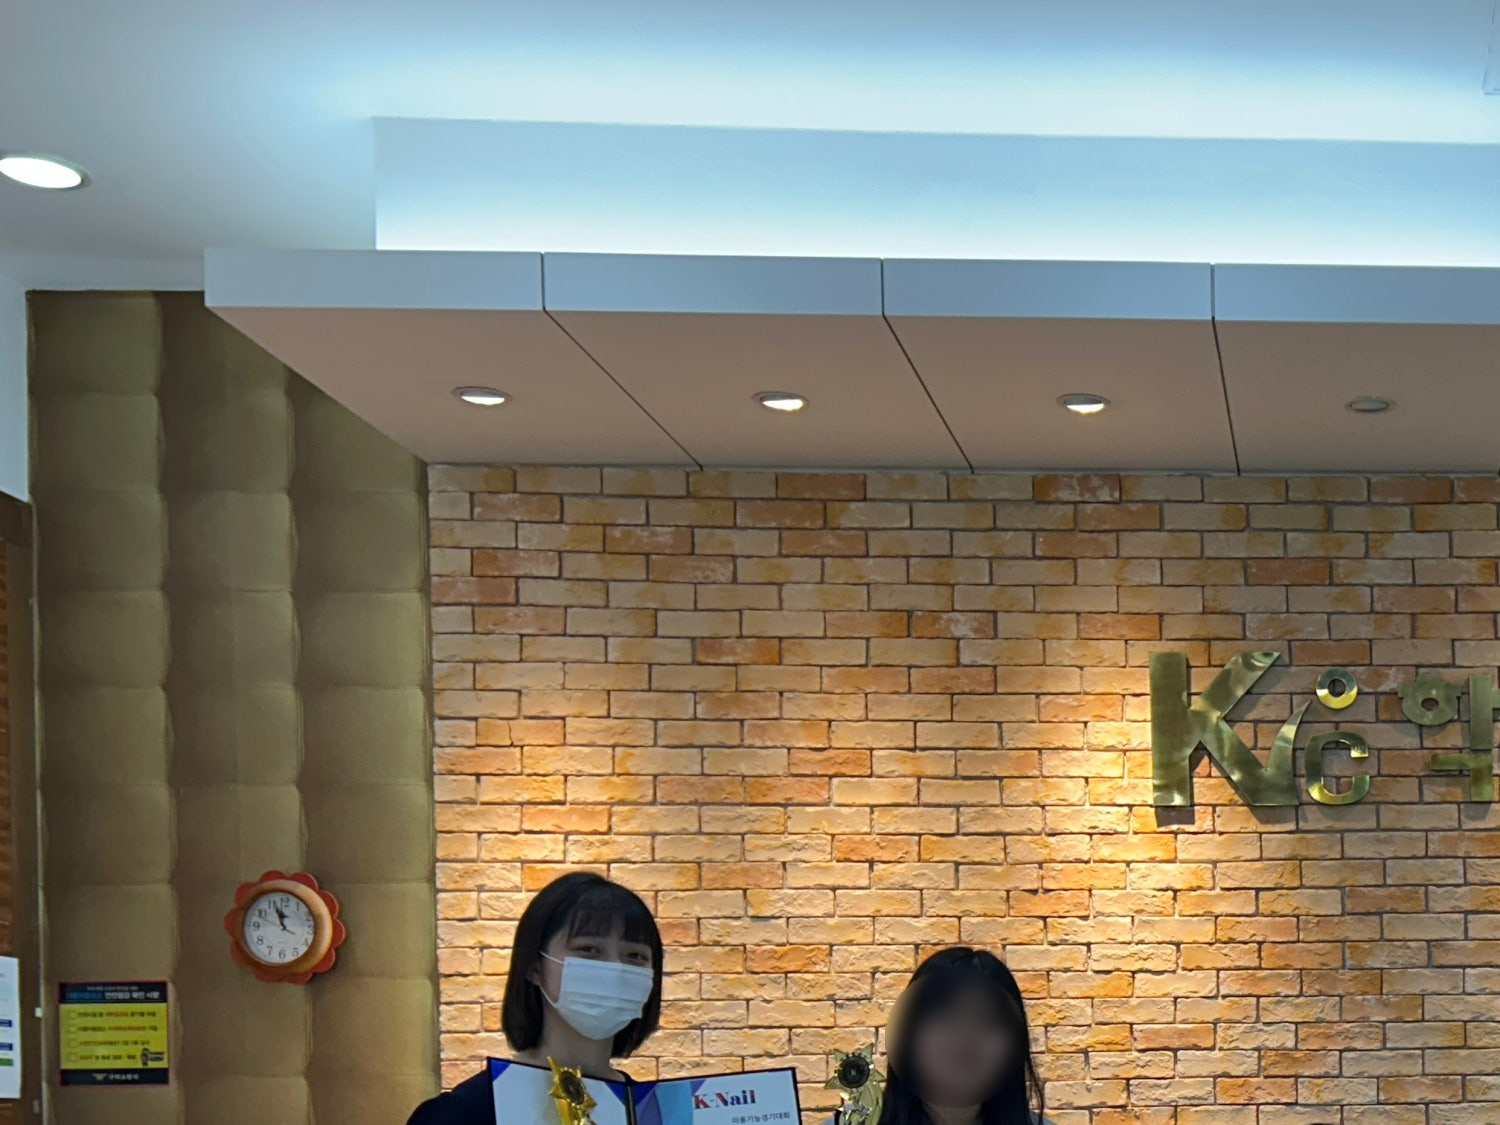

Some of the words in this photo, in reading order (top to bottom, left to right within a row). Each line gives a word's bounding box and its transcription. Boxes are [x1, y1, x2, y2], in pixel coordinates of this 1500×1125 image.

[253, 921, 260, 931] 9
[256, 935, 264, 945] 8
[266, 946, 273, 955] 7
[279, 949, 286, 959] 6
[292, 947, 299, 957] 5
[693, 1090, 756, 1109] K-Nail
